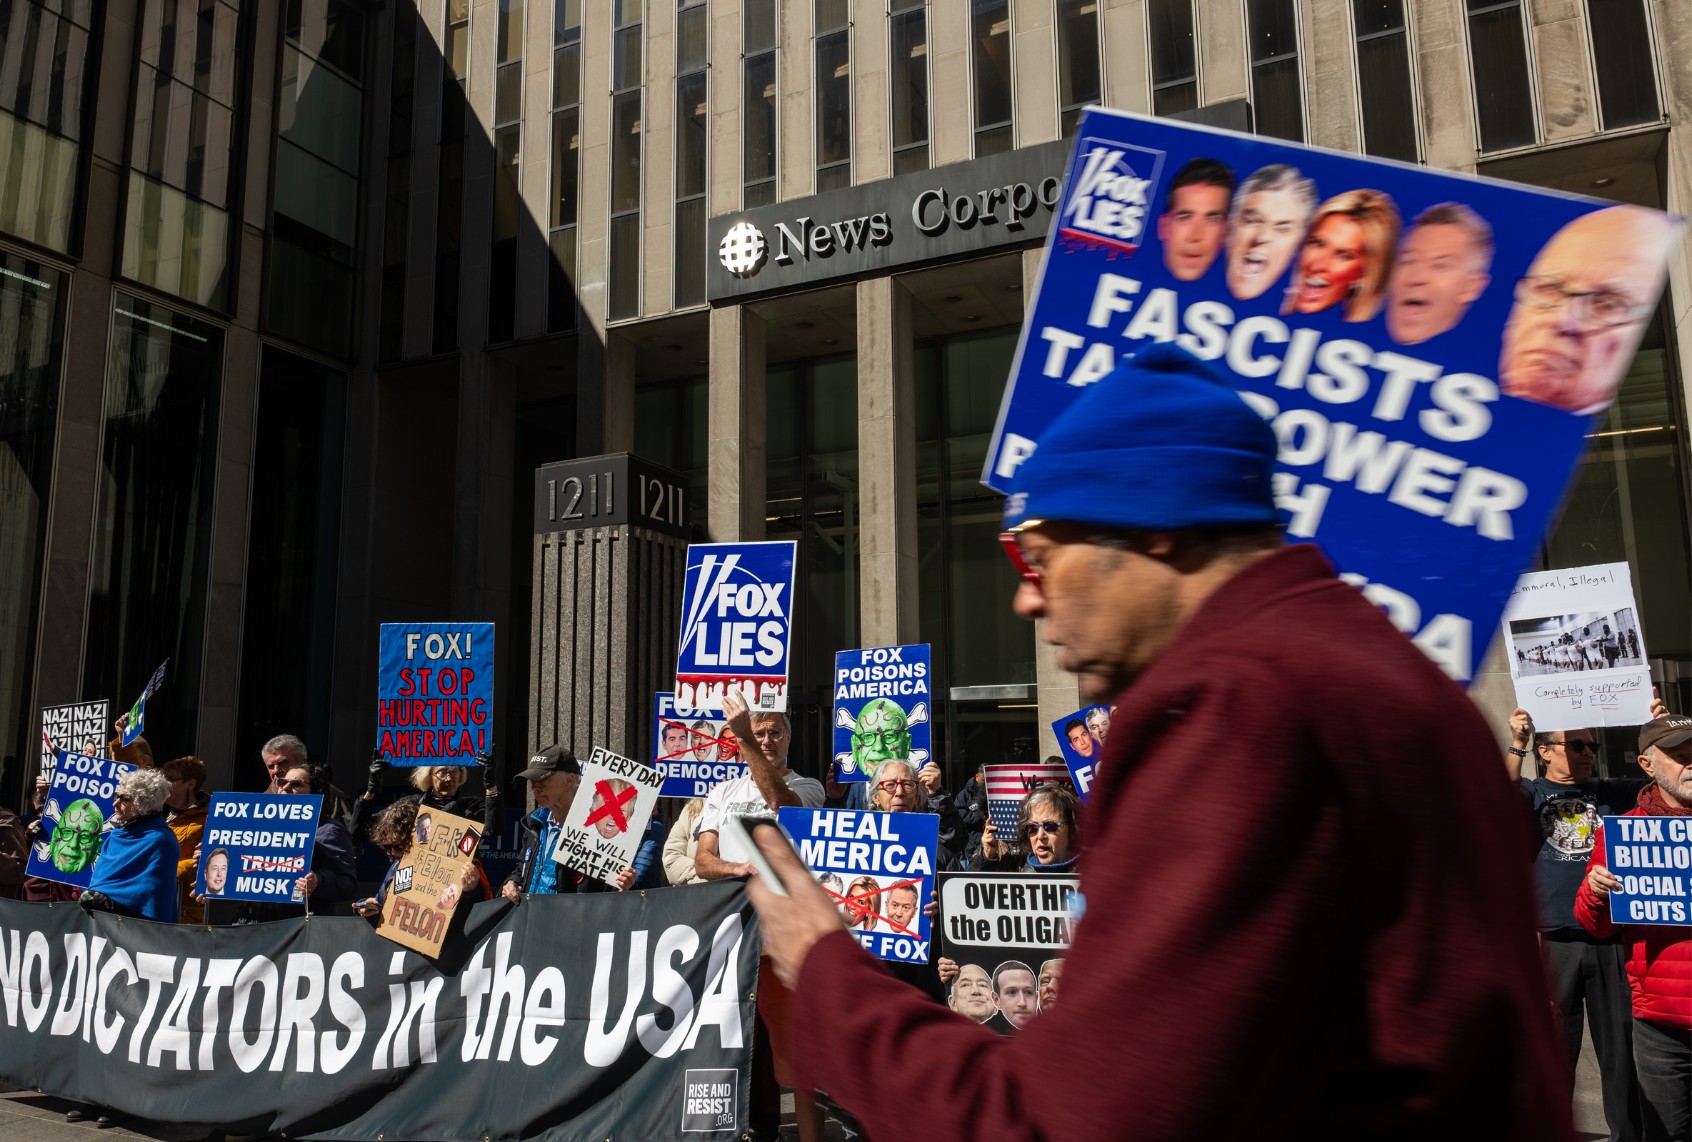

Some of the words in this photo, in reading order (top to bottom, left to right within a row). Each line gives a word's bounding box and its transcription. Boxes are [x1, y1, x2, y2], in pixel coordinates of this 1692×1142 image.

[1095, 170, 1152, 205] FOX
[1072, 195, 1146, 239] LIES
[774, 212, 890, 261] News
[1087, 273, 1500, 443] FASCISTS
[547, 471, 614, 522] 1211
[639, 474, 684, 527] 1211
[717, 582, 786, 618] FOX
[405, 632, 472, 660] FOX!
[694, 620, 785, 667] LIES
[861, 647, 902, 666] FOX
[397, 667, 475, 696] STOP
[837, 662, 927, 683] POISONS
[836, 679, 928, 699] AMERICA
[43, 707, 72, 725] NAZI
[74, 703, 107, 721] NAZI
[379, 697, 487, 727] HURTING
[1571, 698, 1582, 710] by
[73, 719, 106, 737] NAZI
[379, 729, 485, 758] AMERICA!
[64, 753, 106, 777] FOX
[108, 762, 129, 781] IS
[213, 802, 249, 818] FOX
[253, 803, 314, 820] LOVES
[208, 829, 310, 849] PRESIDENT
[810, 810, 900, 842] HEAL
[1617, 819, 1665, 842] TAX
[559, 837, 602, 864] FIGHT
[567, 826, 589, 845] WE
[596, 838, 629, 864] WILL
[241, 854, 305, 873] TRUMP
[395, 866, 413, 886] NO!
[235, 876, 290, 895] MUSK
[1629, 900, 1686, 922] CUTS
[950, 914, 991, 942] the
[880, 935, 929, 961] FOX
[0, 926, 52, 1034] NO
[50, 931, 367, 1075] DICTATORS
[371, 951, 444, 1070] in
[460, 930, 566, 1067] the
[583, 912, 744, 1068] USA
[688, 1083, 709, 1098] RISE
[711, 1083, 731, 1098] AND
[686, 1098, 732, 1115] RESIST
[715, 1112, 734, 1127] .ORG
